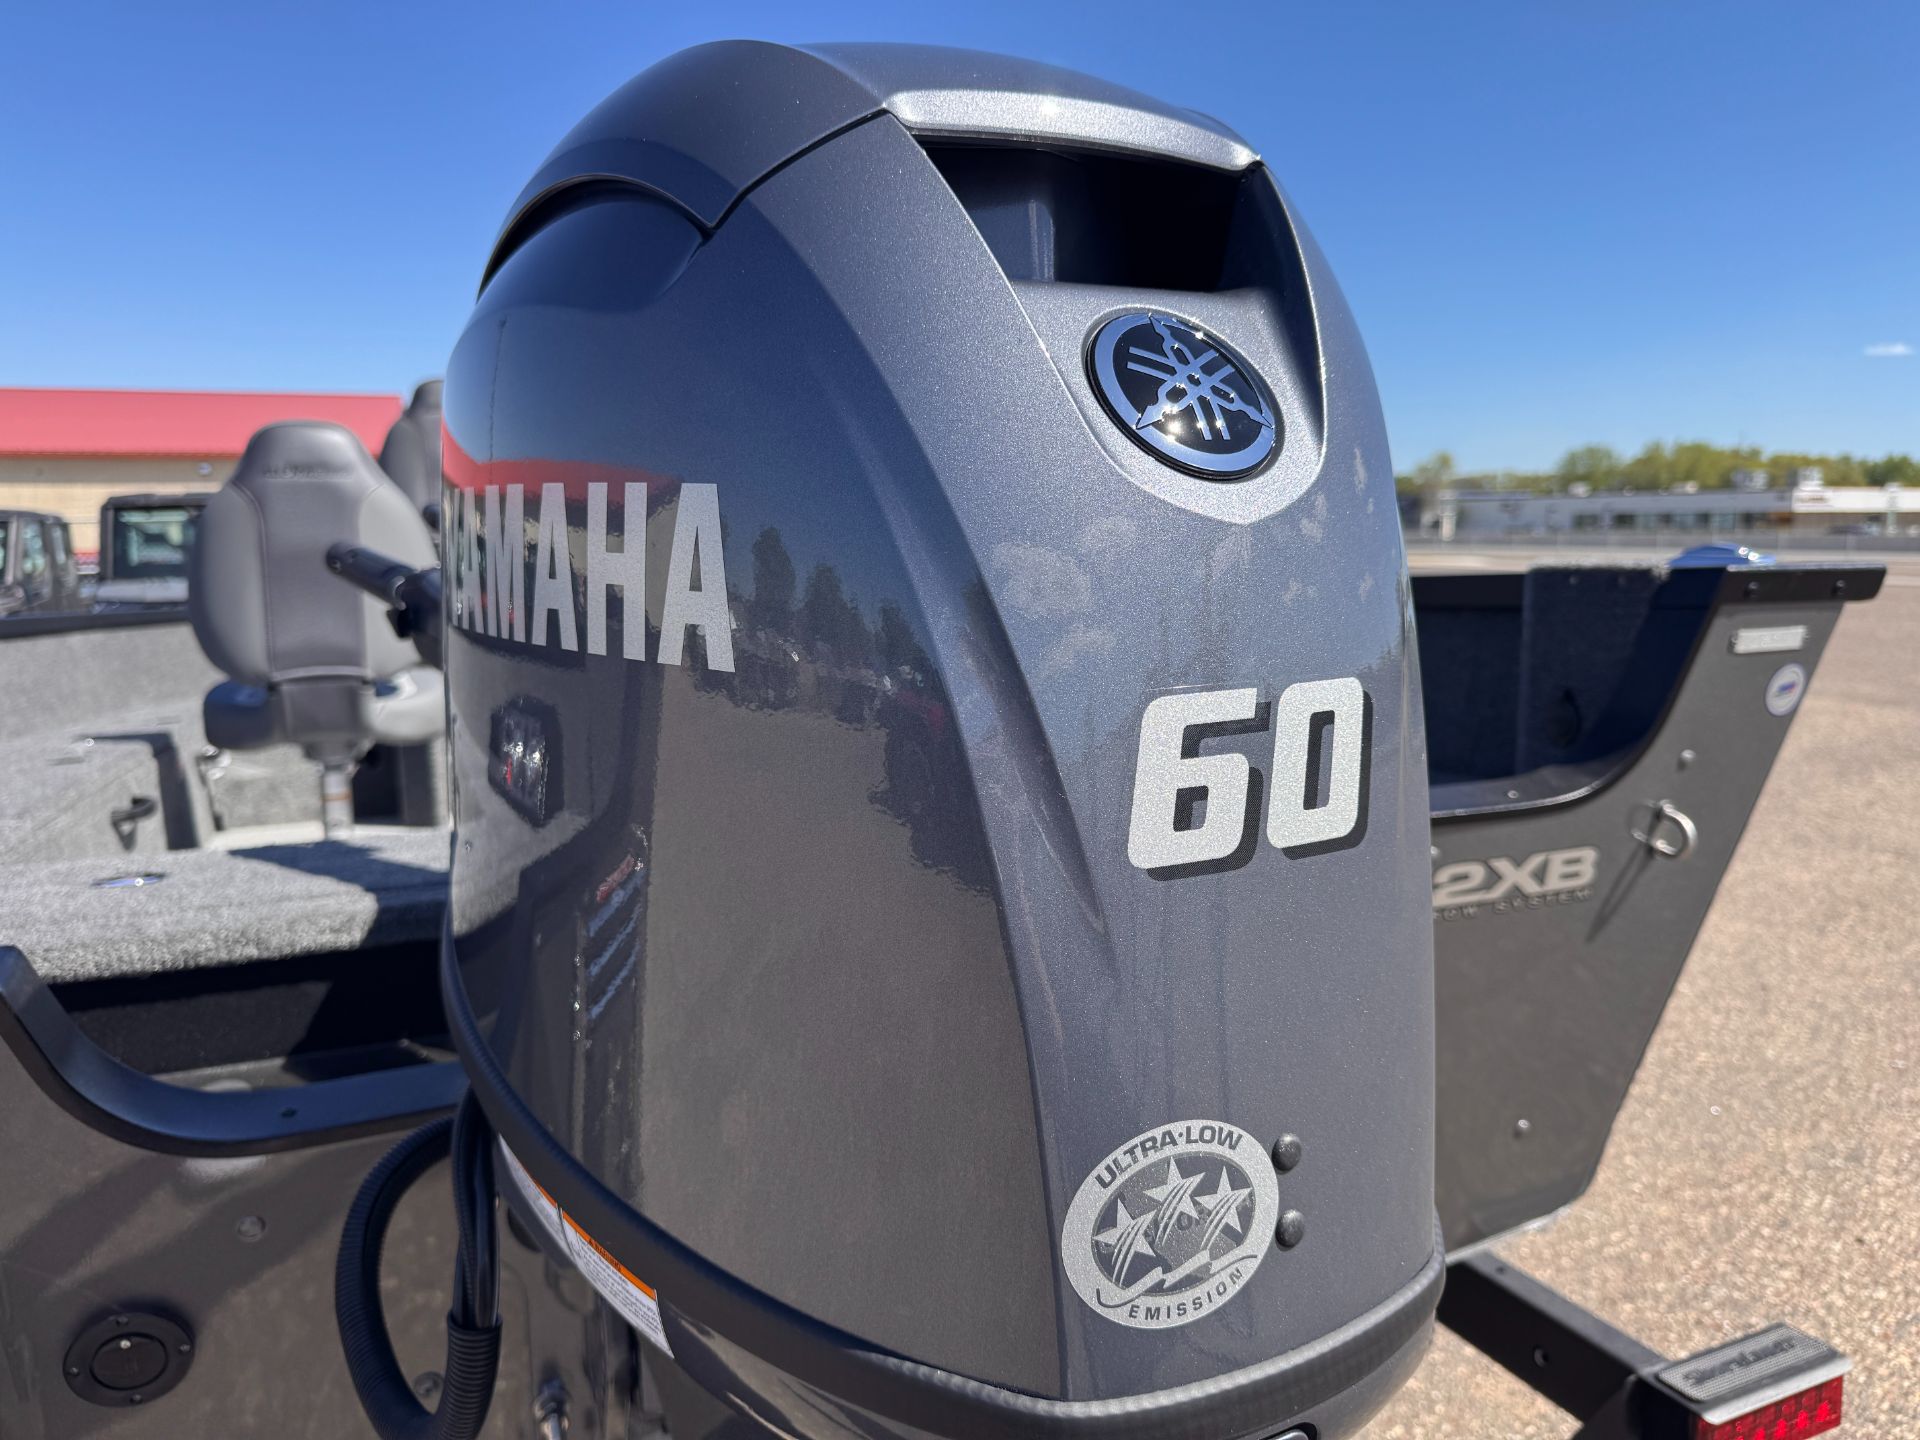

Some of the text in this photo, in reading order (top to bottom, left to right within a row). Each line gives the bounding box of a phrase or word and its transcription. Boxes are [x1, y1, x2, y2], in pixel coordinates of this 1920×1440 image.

[447, 482, 736, 673] YAMAHA
[1128, 676, 1373, 881] 60
[1432, 845, 1598, 908] 2XB
[1128, 1267, 1244, 1321] EMISSION
